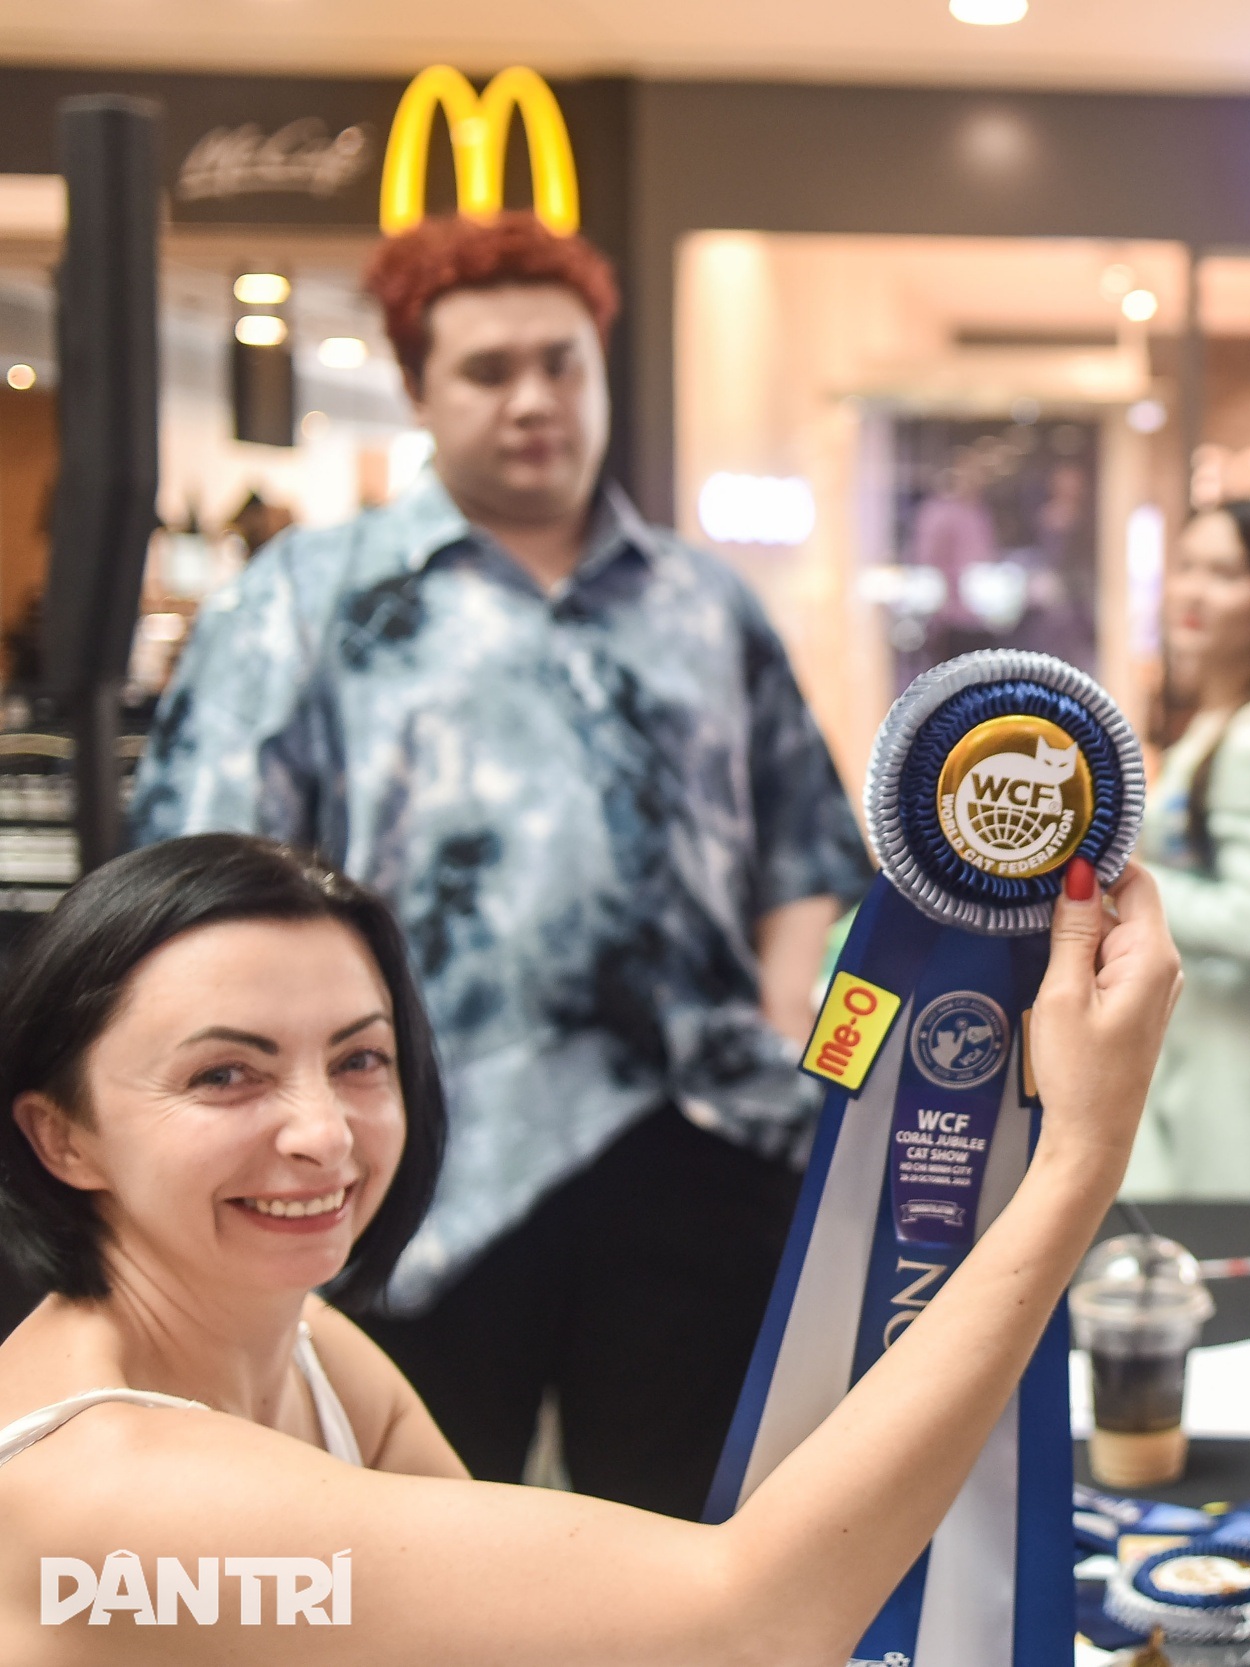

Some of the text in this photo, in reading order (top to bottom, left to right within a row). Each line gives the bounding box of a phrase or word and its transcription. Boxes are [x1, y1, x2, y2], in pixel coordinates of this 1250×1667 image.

[971, 772, 1054, 808] WCF
[941, 793, 1075, 874] WORLD CAT FEDERATION
[917, 1108, 971, 1134] WCF
[906, 1146, 970, 1164] CAT SHOW
